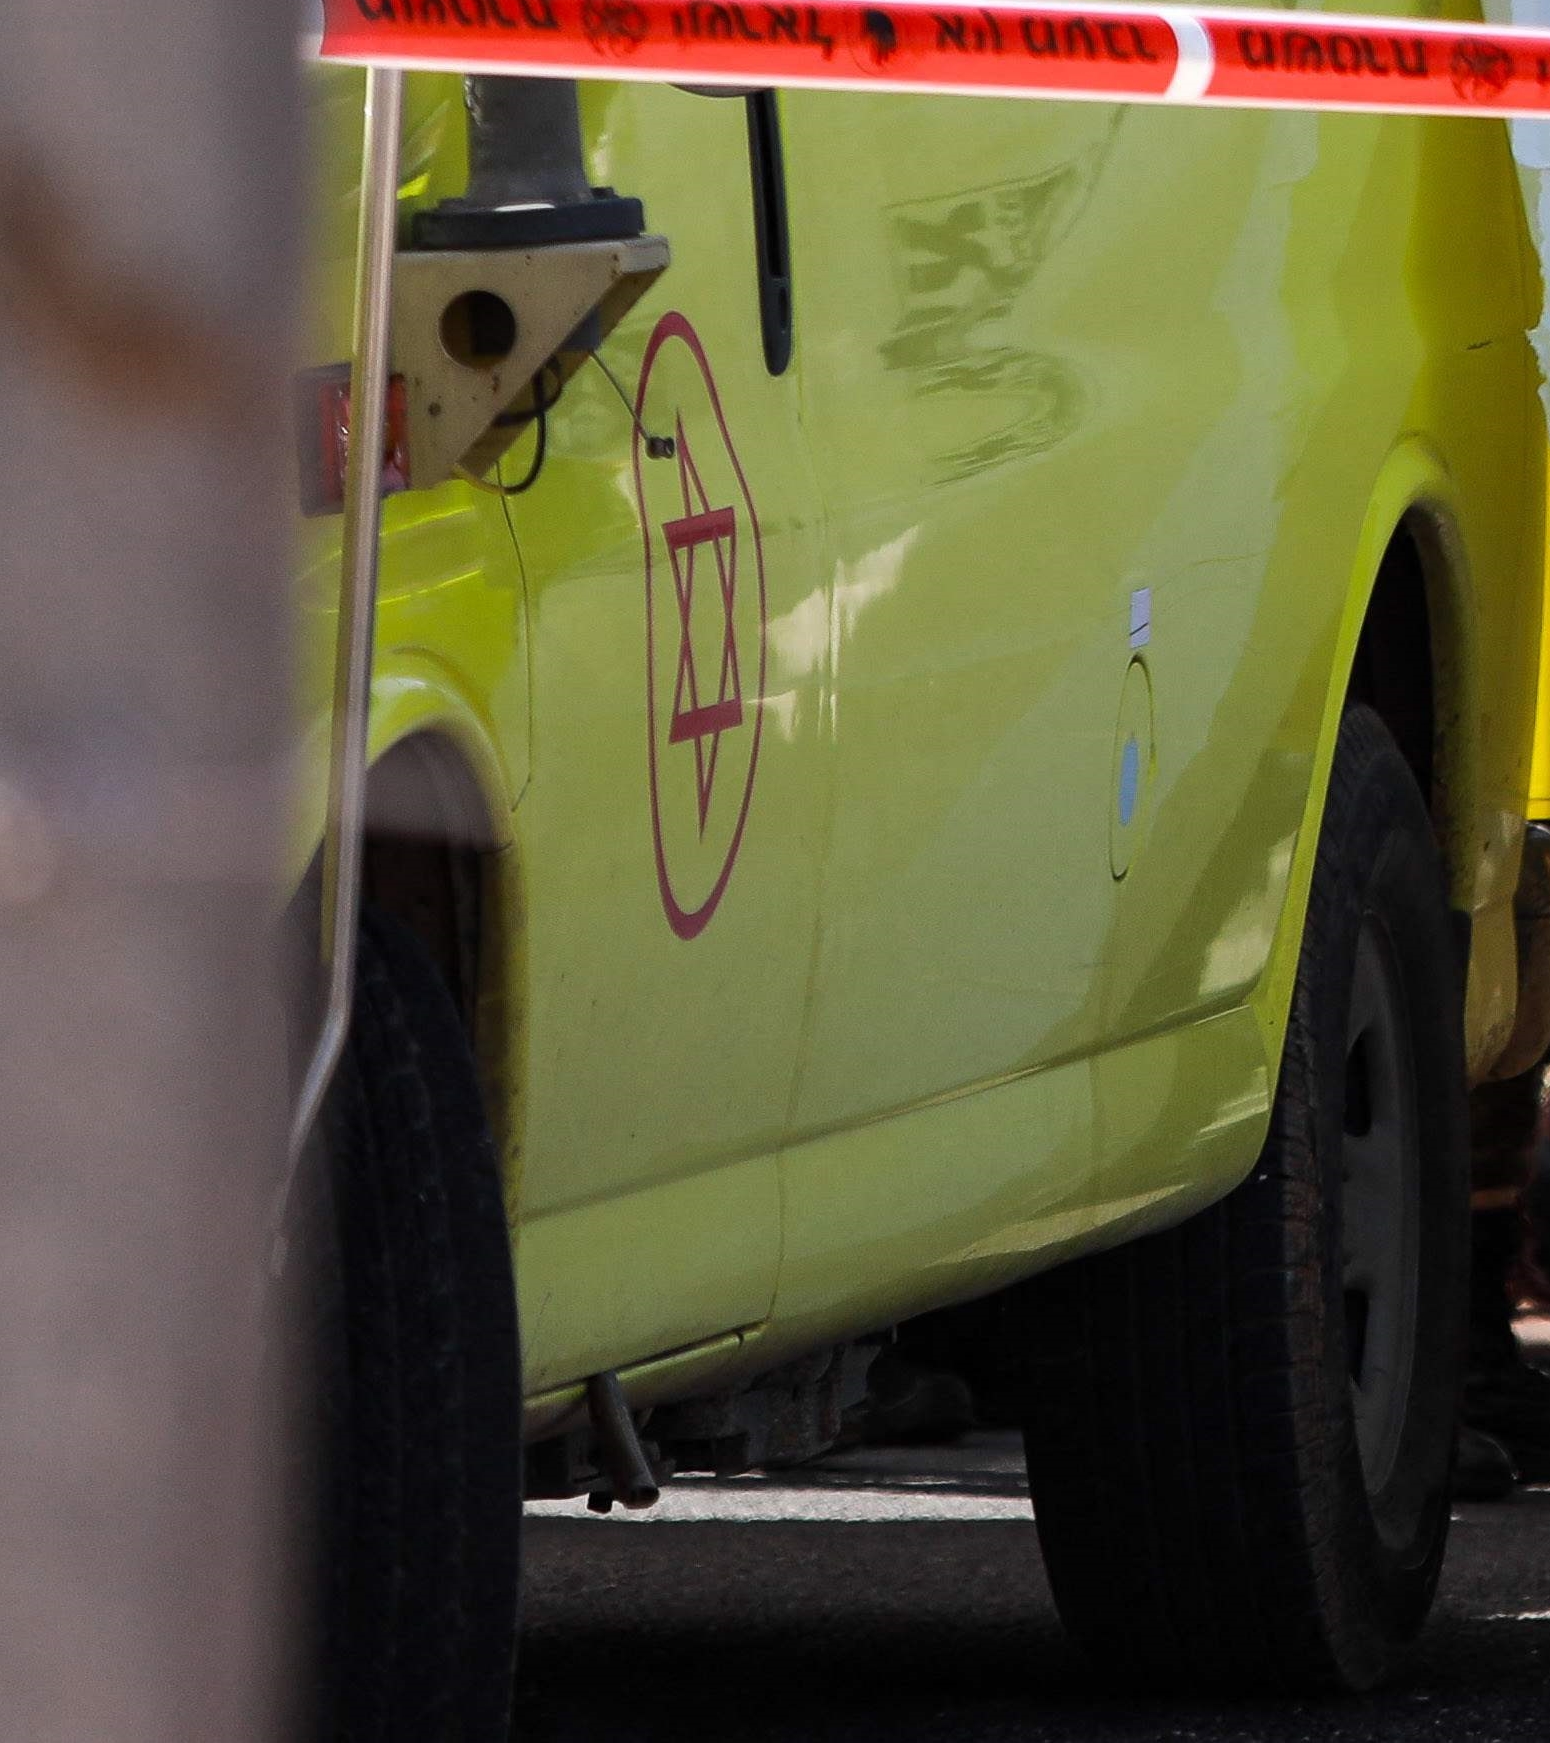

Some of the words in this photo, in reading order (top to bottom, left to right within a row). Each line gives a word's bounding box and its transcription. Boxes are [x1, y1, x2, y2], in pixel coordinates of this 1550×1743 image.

[933, 8, 1005, 55] אין
[1019, 14, 1161, 63] מעבר
[1237, 26, 1429, 77] משטרת
